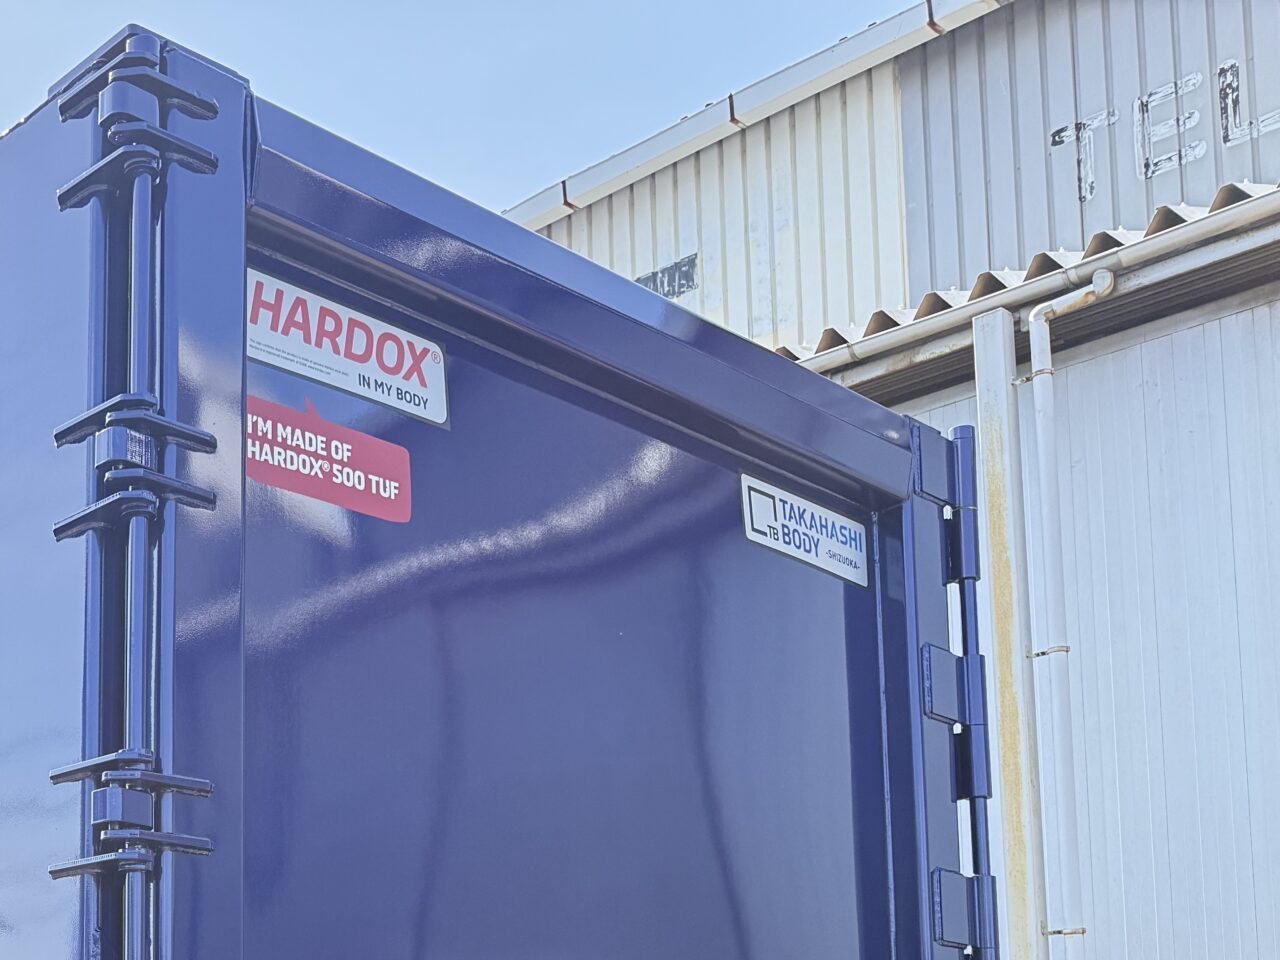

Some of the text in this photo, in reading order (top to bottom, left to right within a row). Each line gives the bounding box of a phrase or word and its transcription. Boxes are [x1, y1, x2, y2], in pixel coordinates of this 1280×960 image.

[358, 373, 428, 410] IN MY BODY
[277, 422, 327, 456] MADE
[331, 440, 352, 462] OF
[332, 464, 365, 490] 500
[368, 475, 399, 500] TUF
[767, 525, 779, 541] TB
[779, 498, 863, 553] TAKAHASHI
[781, 523, 820, 558] BODY
